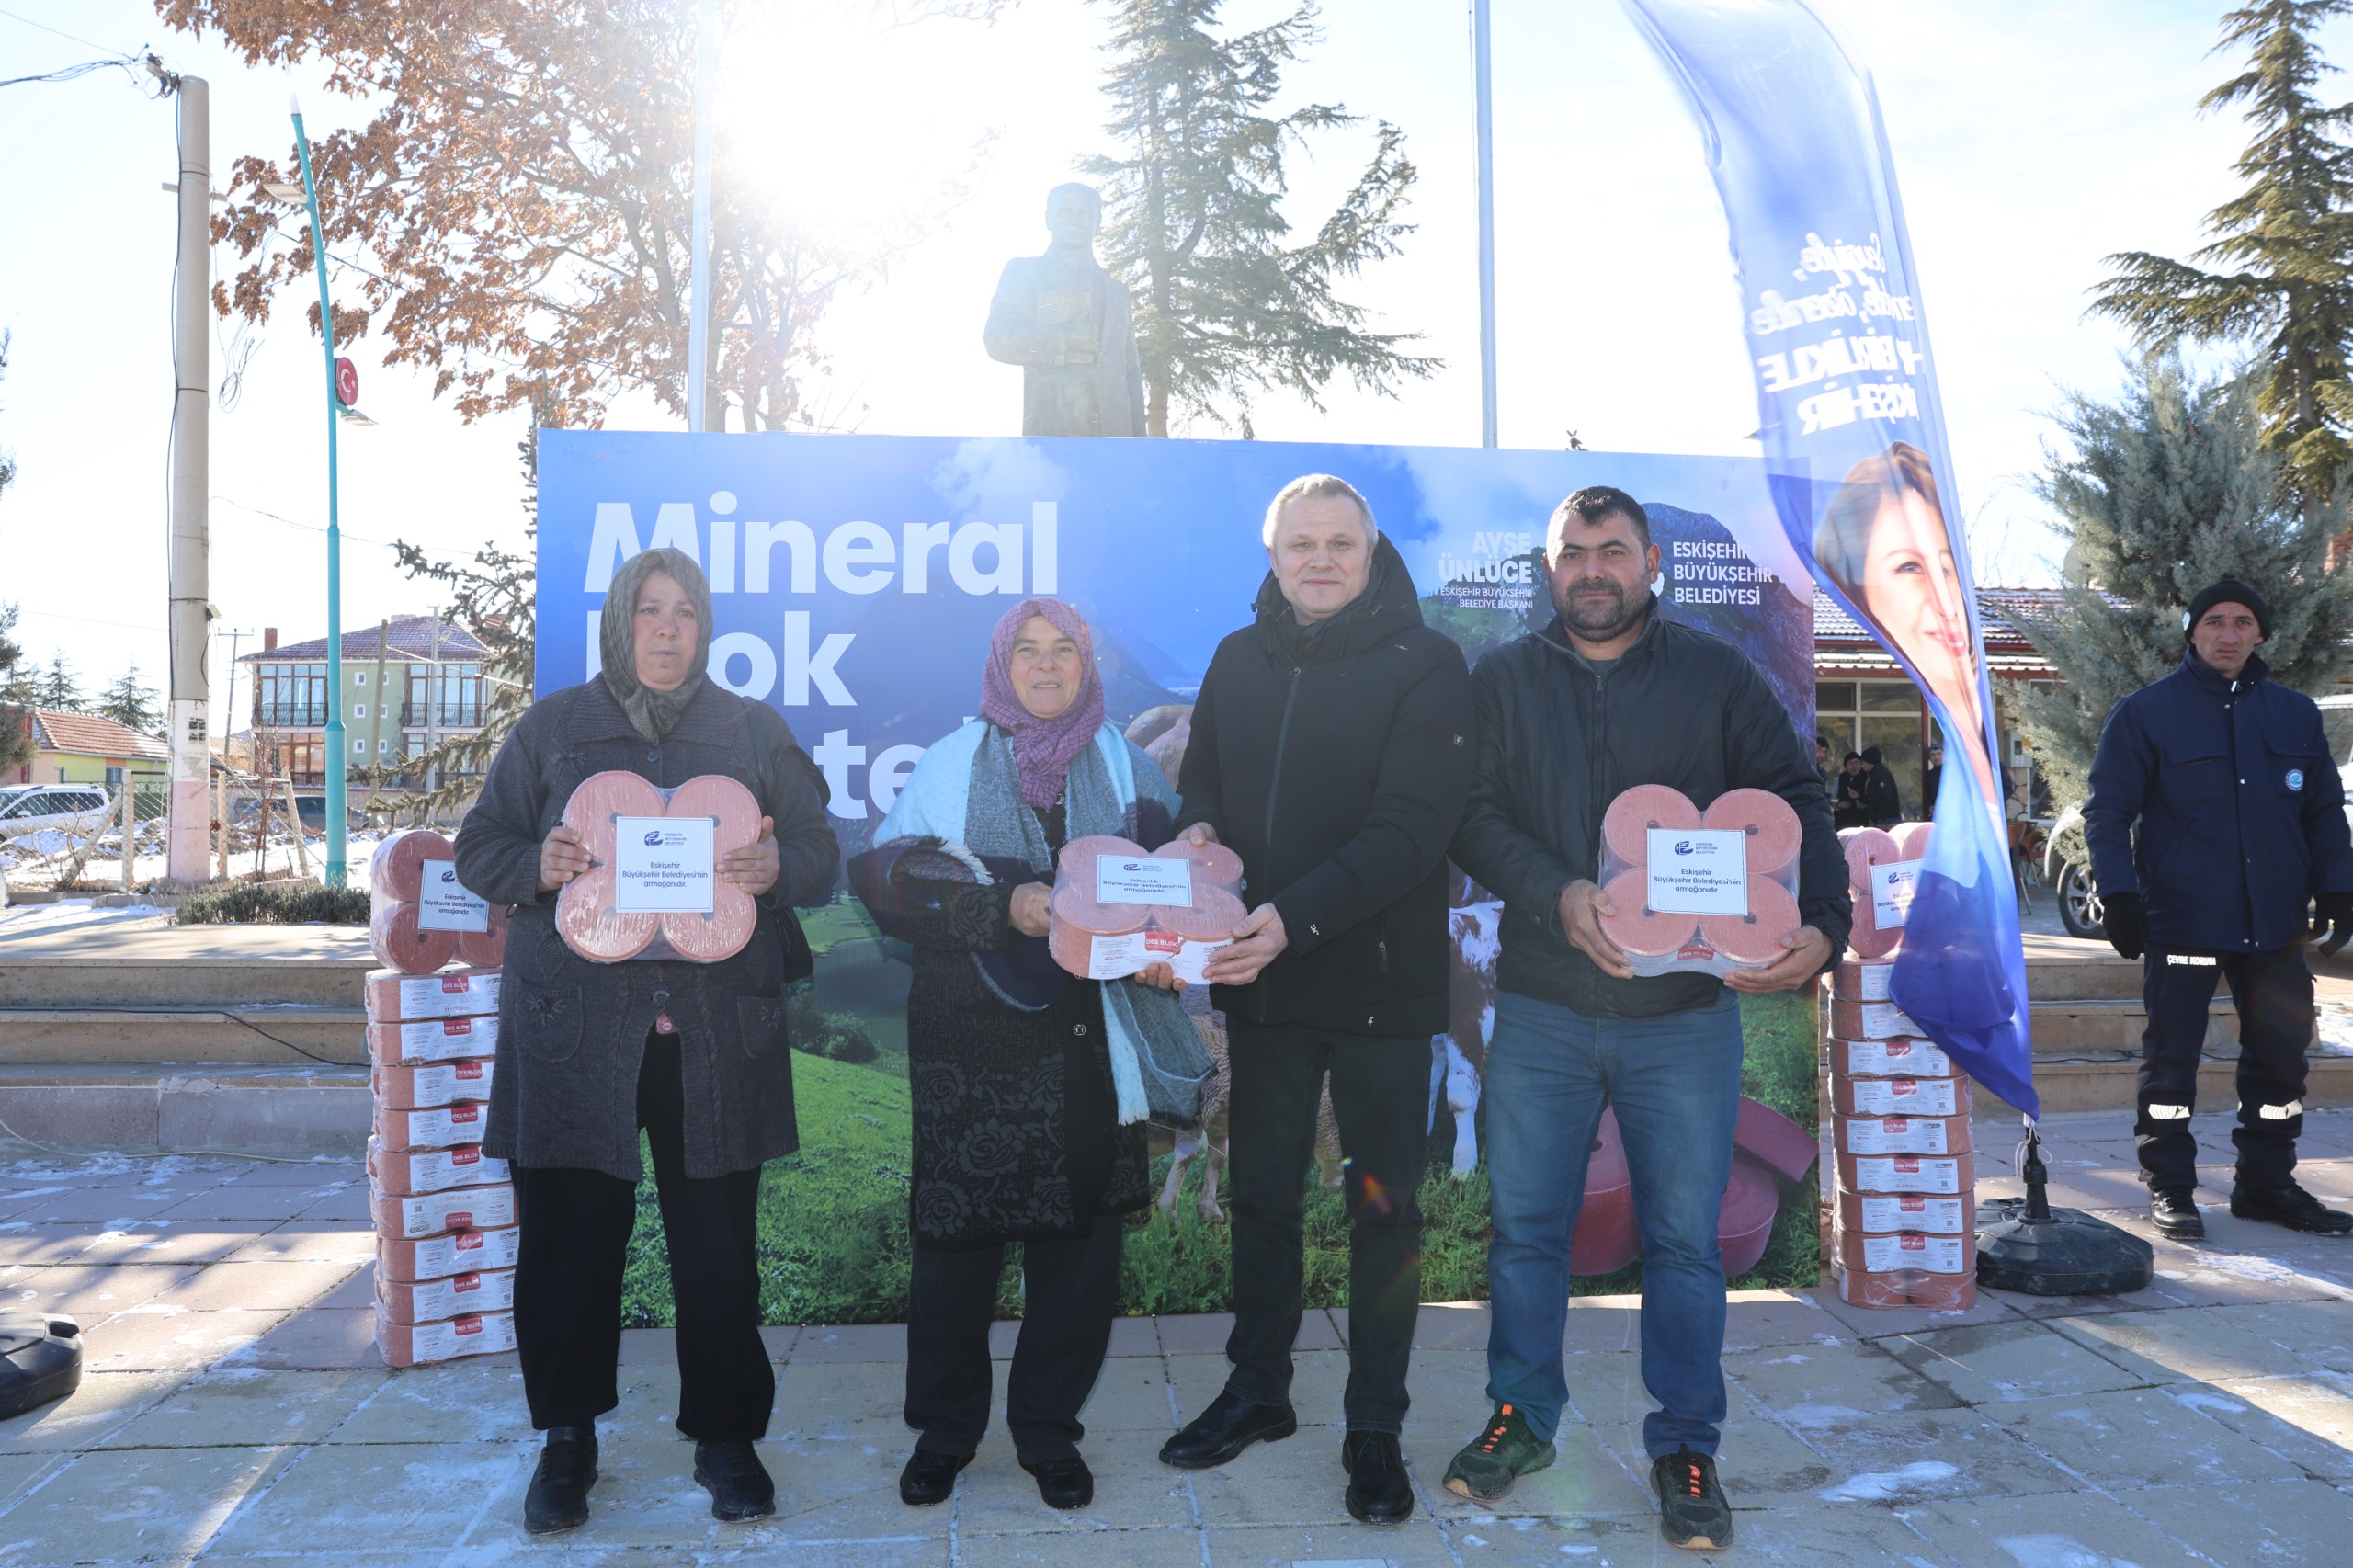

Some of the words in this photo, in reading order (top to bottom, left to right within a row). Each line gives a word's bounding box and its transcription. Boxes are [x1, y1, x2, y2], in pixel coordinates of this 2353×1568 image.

[584, 491, 1058, 595] Mineral
[1472, 531, 1531, 558] AYŞE
[1673, 540, 1751, 561] ESKİŞEHİR
[1438, 552, 1532, 584] ÜNLÜCE
[1674, 562, 1773, 584] BÜYÜKŞEHİR
[1440, 586, 1481, 597] ESKİŞEHİR
[1483, 587, 1532, 597] BÜYÜKŞEHİR
[1675, 585, 1760, 605] BELEDİYESİ
[1460, 598, 1496, 608] BELEDİYE
[1498, 599, 1532, 609] BAŞKANI
[2167, 955, 2189, 965] ÇEVRE
[2189, 956, 2216, 966] KORUMA
